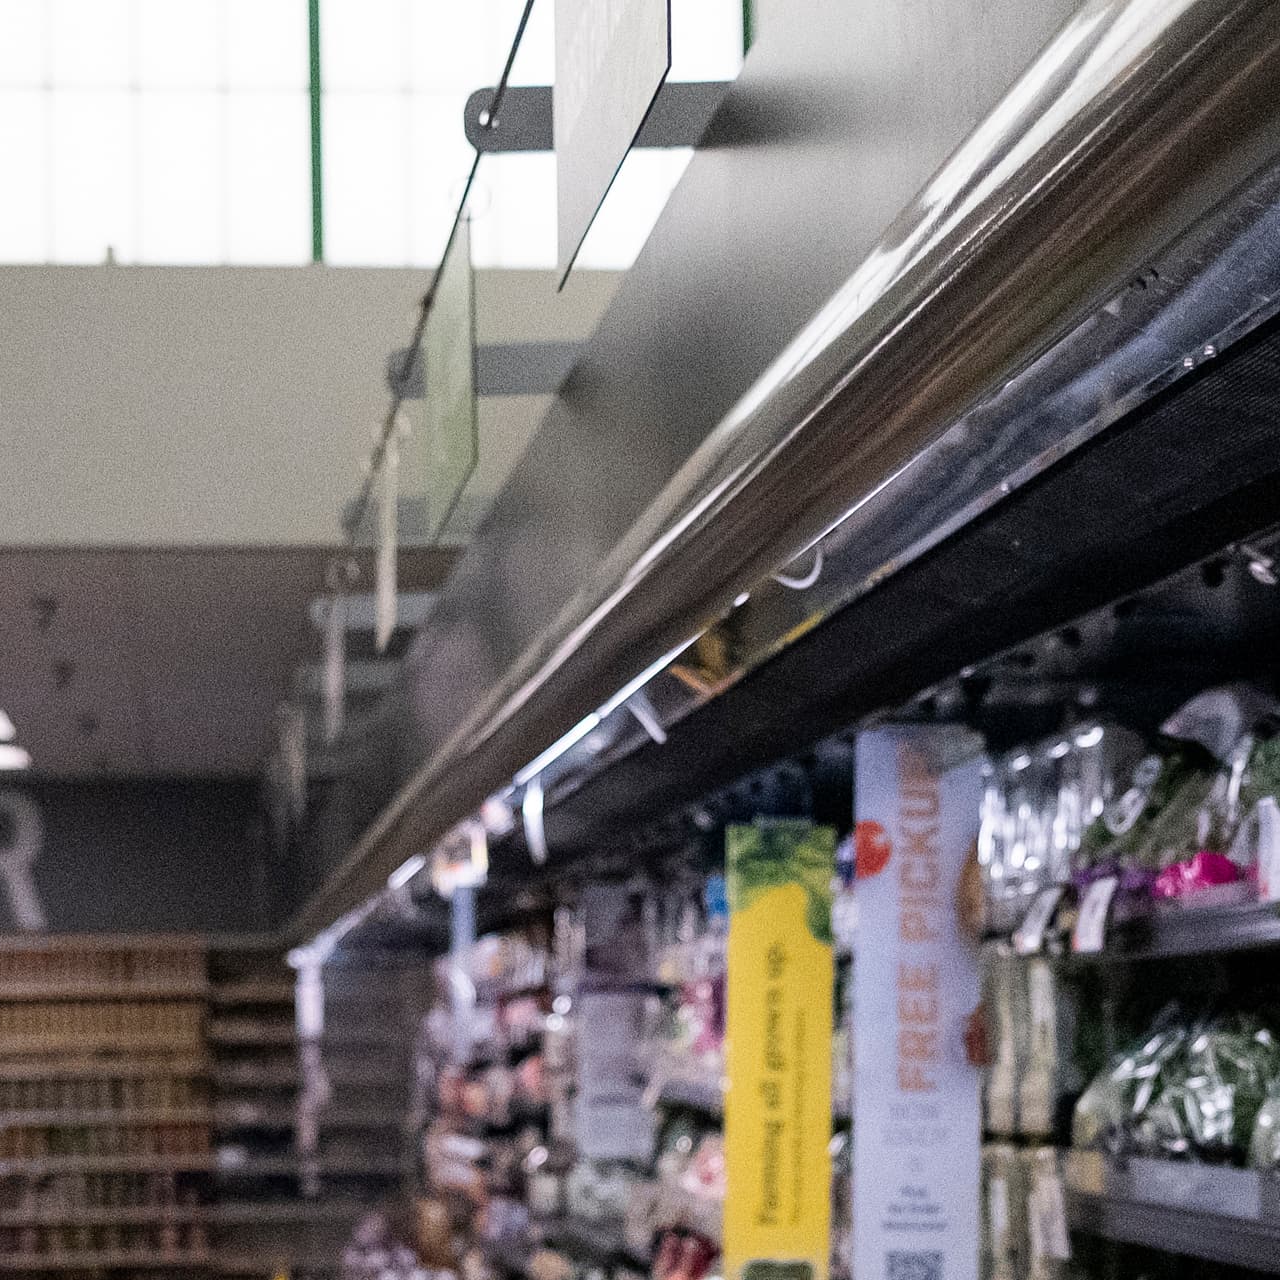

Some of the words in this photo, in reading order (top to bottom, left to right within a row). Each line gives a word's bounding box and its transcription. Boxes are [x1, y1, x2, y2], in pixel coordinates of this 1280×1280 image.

[897, 742, 940, 943] PICKUP
[897, 962, 939, 1092] FREE
[757, 1121, 784, 1226] Farming
